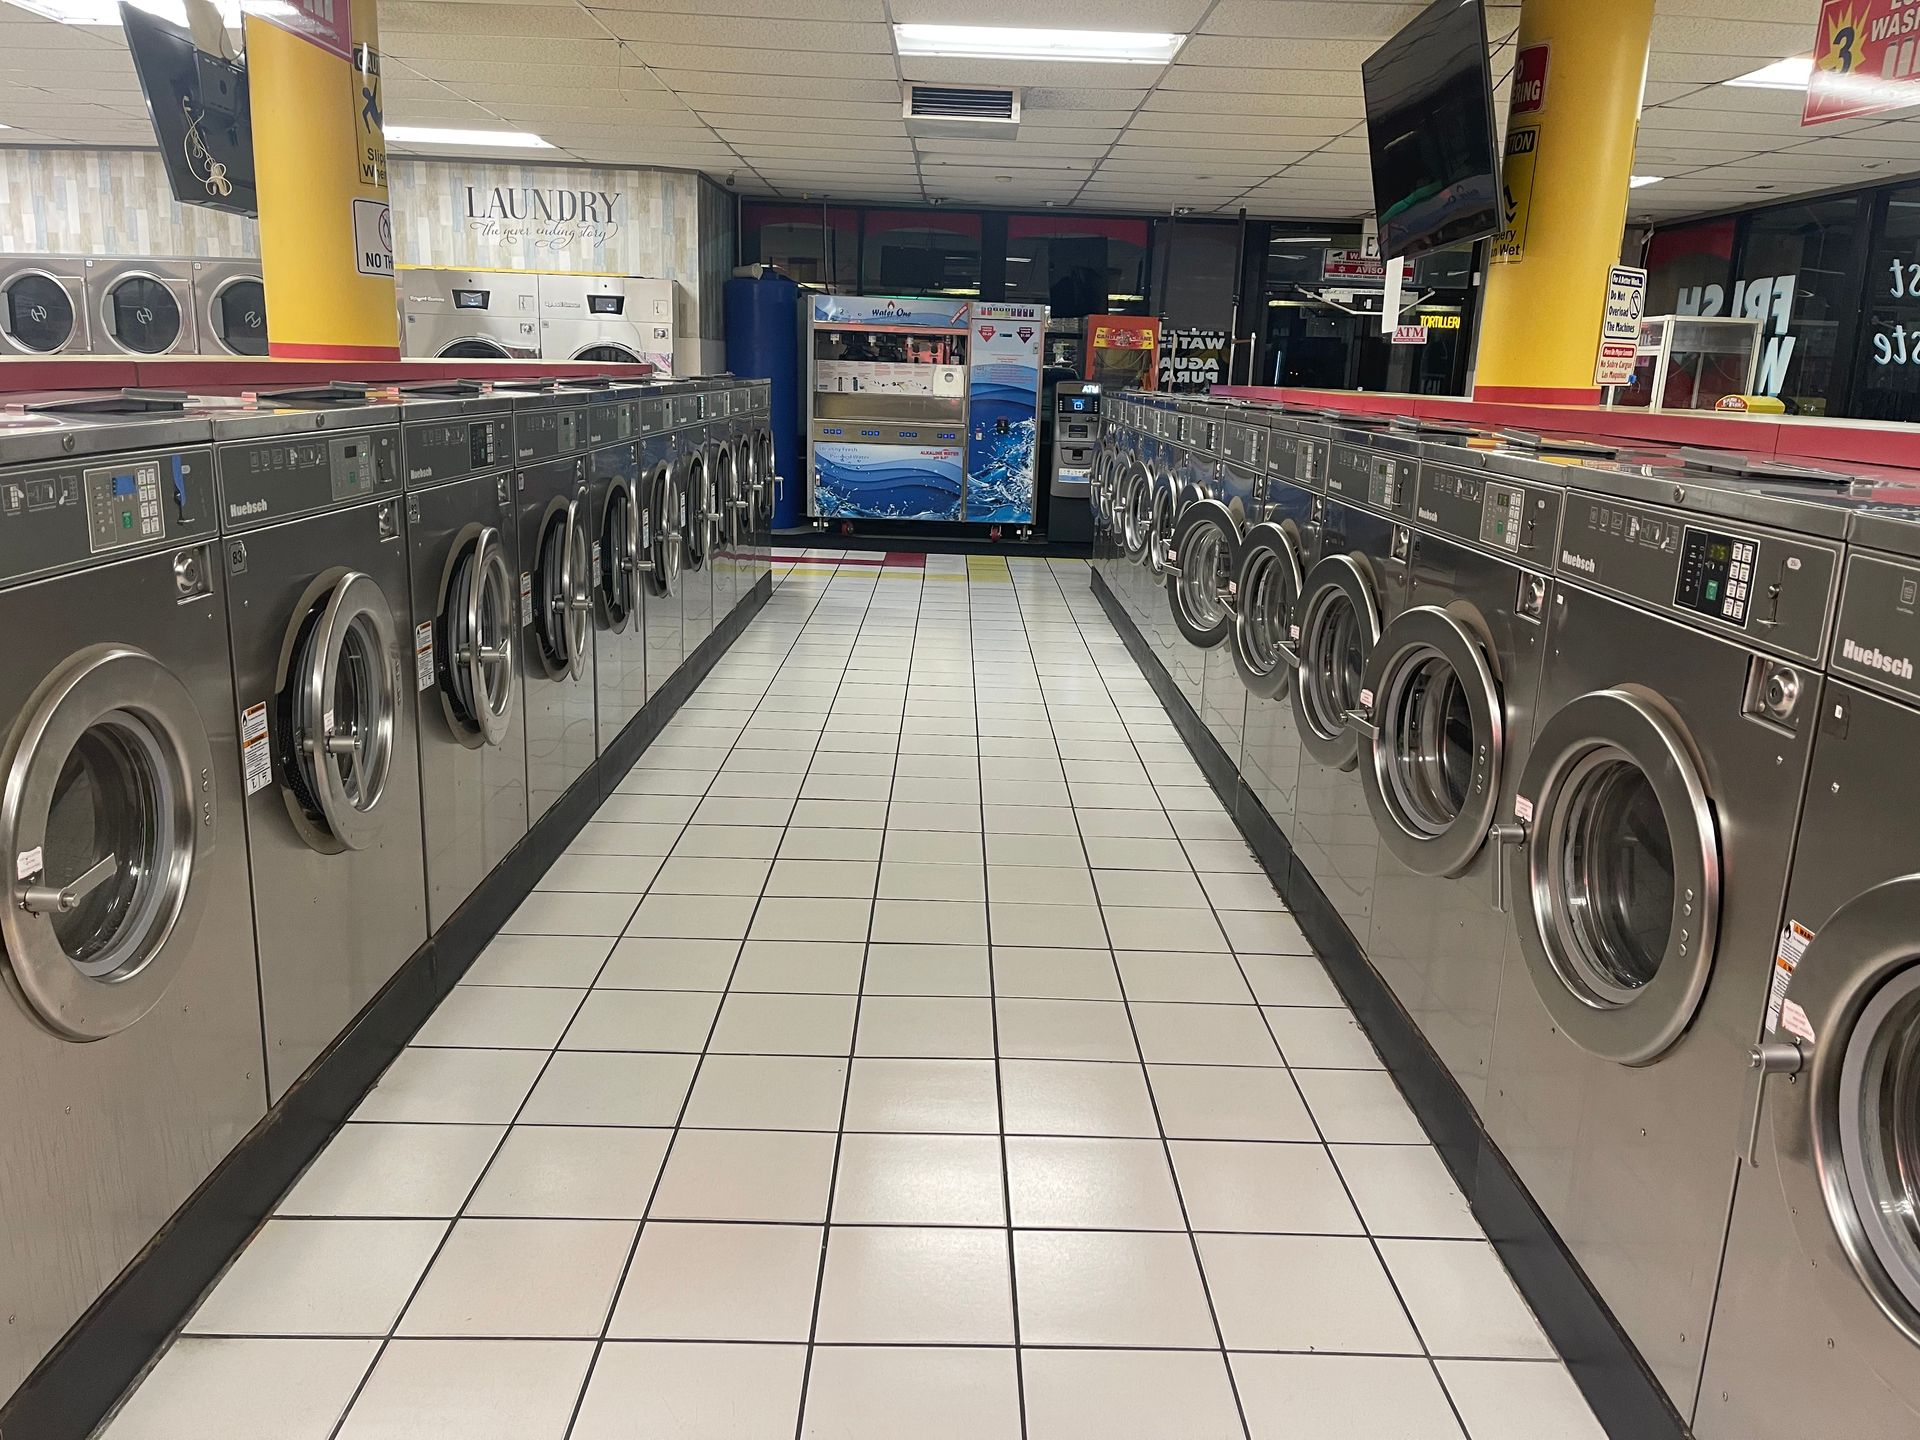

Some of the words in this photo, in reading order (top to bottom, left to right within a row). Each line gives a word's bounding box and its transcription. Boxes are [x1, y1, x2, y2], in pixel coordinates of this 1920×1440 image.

[1831, 26, 1855, 74] 3
[465, 186, 622, 223] LAUNDRY
[469, 221, 500, 237] The
[499, 227, 531, 248] never
[535, 219, 576, 250] ending
[577, 222, 618, 248] story
[1500, 243, 1520, 256] Wet
[366, 252, 382, 268] NO
[1356, 266, 1384, 274] AVISO
[1610, 290, 1617, 300] Do
[1617, 290, 1626, 300] Not
[872, 308, 894, 317] Water
[896, 308, 912, 317] One
[1608, 305, 1629, 317] Overload
[1395, 327, 1425, 338] ATM
[1606, 321, 1615, 331] The
[1615, 323, 1635, 333] Machines
[1082, 385, 1099, 394] ATM
[230, 499, 268, 518] Huebsch
[232, 550, 243, 565] 83
[1562, 550, 1595, 573] Huebsch
[1842, 638, 1914, 680] Huebsch
